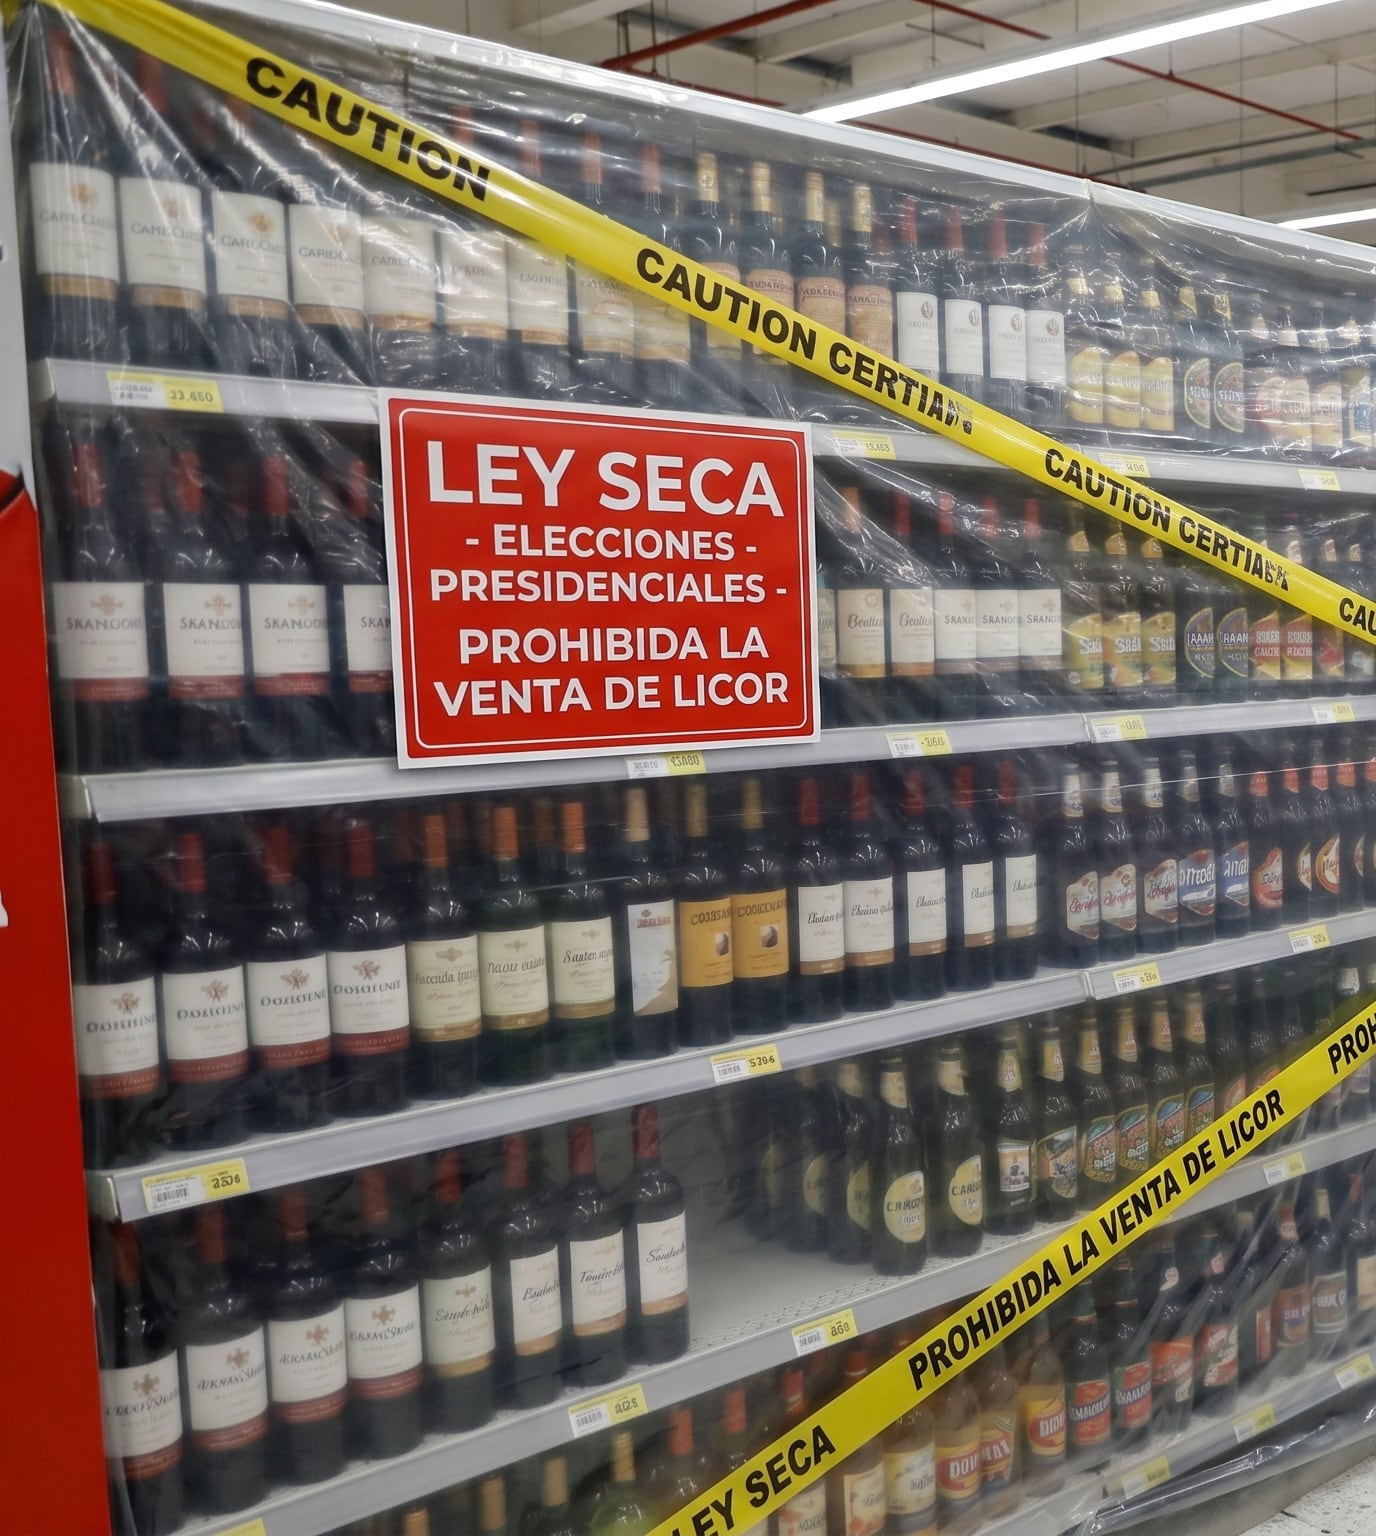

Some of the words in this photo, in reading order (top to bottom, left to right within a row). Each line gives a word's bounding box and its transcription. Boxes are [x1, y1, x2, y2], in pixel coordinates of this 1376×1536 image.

[245, 57, 491, 202] CAUTION
[635, 247, 817, 361] CAUTION
[426, 440, 575, 507] LEY
[598, 450, 785, 518] SECA
[1044, 448, 1172, 533] CAUTION
[493, 523, 735, 561] ELECCIONES
[430, 568, 766, 603] PRESIDENCIALES
[459, 627, 708, 665] PROHIBIDA
[719, 626, 769, 660] LA
[433, 677, 592, 718] VENTA
[604, 674, 661, 710] DE
[674, 671, 790, 708] LICOR
[908, 1257, 1062, 1392] PROHIBIDA
[1062, 1228, 1101, 1277] LA
[1098, 1167, 1182, 1246] VENTA
[1182, 1139, 1217, 1186] DE
[1217, 1088, 1285, 1160] LICOR
[744, 1423, 837, 1509] SECA
